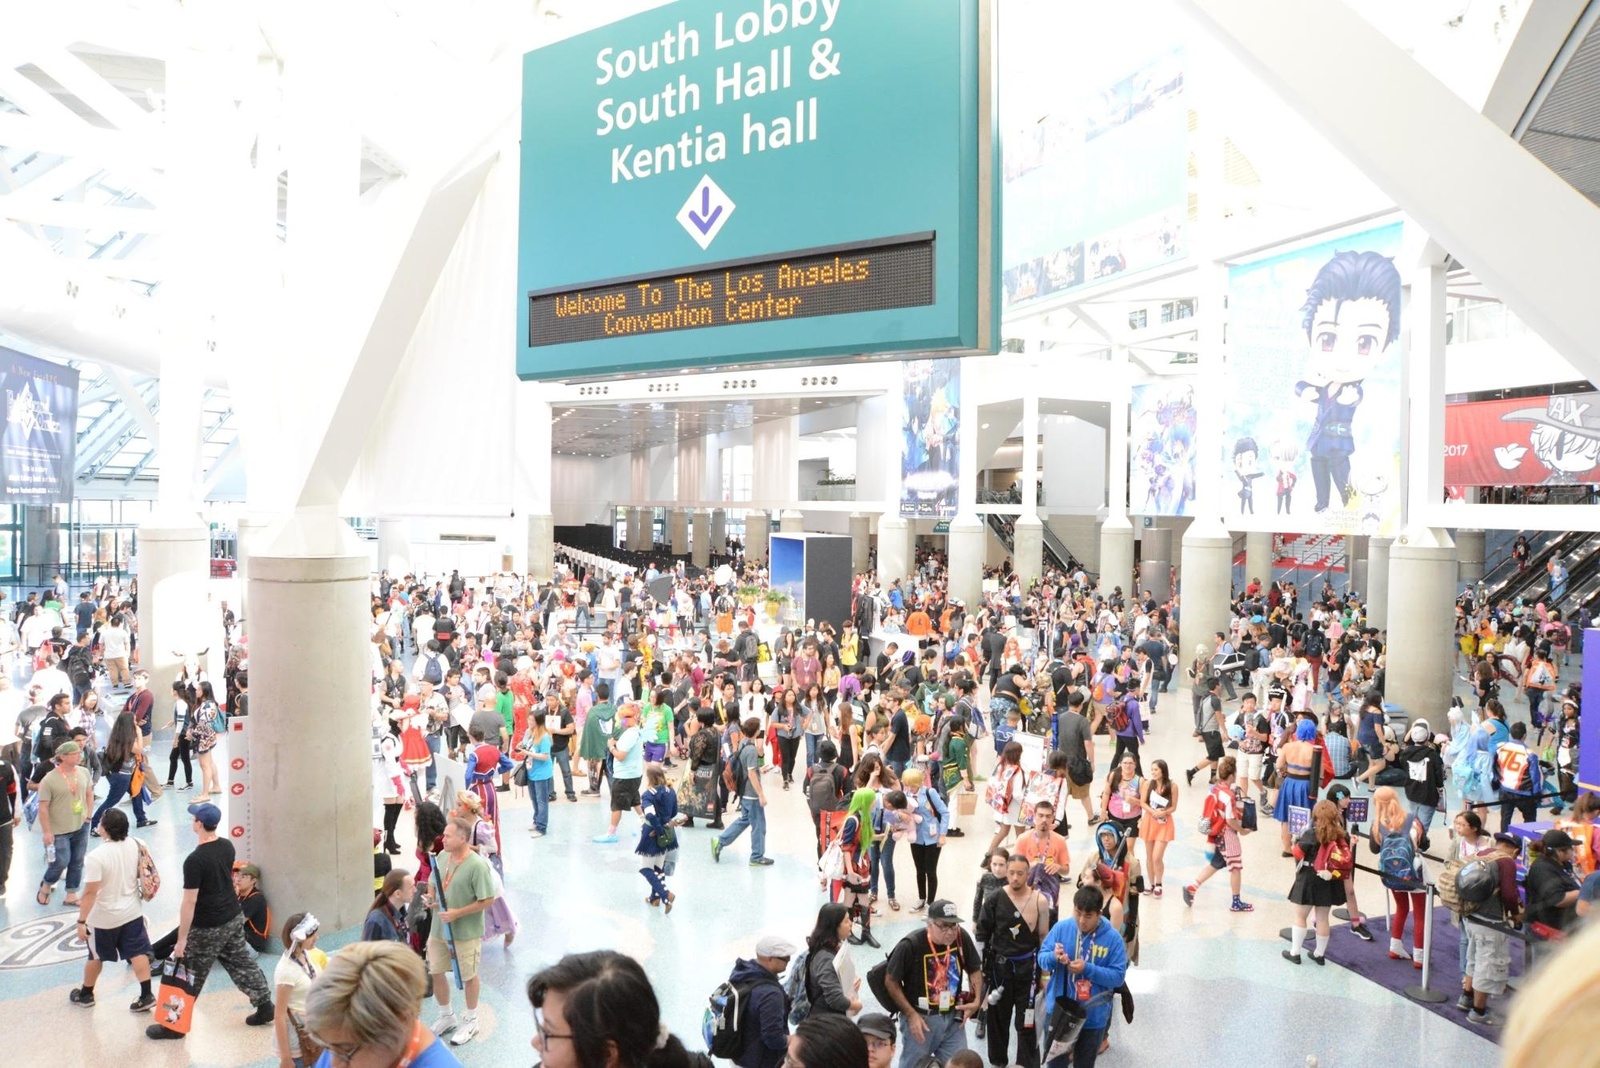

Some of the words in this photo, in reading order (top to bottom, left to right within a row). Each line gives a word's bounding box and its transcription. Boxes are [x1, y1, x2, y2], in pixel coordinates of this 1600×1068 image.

[597, 21, 700, 85] South
[715, 0, 841, 49] Lobby
[597, 75, 700, 136] South
[717, 46, 791, 104] Hall
[809, 38, 841, 80] &
[611, 126, 726, 184] Kentia
[743, 97, 817, 155] hall
[555, 293, 626, 318] Welcome
[637, 283, 662, 306] To
[674, 277, 713, 301] The
[725, 272, 764, 296] Los
[778, 256, 869, 289] Angeles
[604, 303, 713, 335] Convention
[725, 293, 802, 321] Center
[1549, 397, 1590, 428] AX
[1443, 444, 1469, 457] 2017
[1500, 748, 1526, 772] 76
